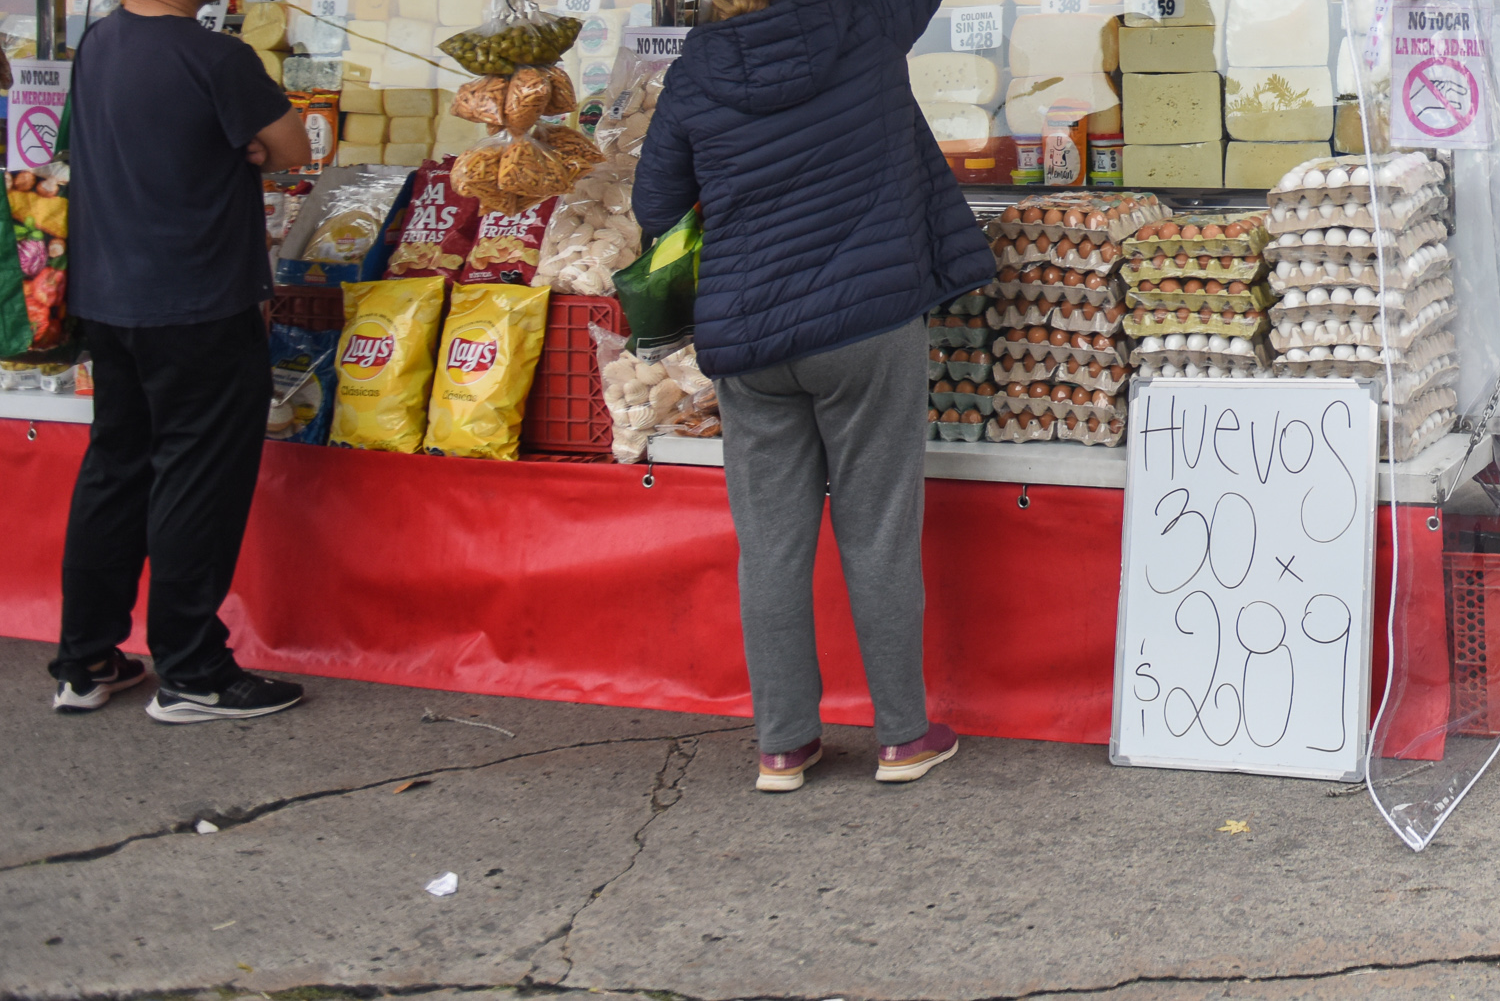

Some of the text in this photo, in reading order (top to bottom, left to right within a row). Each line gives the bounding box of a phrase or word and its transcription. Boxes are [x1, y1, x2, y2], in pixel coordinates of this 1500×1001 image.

[961, 12, 993, 21] COLONIA
[1408, 11, 1470, 31] NO TOCAR
[956, 20, 998, 33] SIN SAL
[637, 38, 650, 54] NO
[960, 32, 993, 49] $428
[1396, 37, 1408, 54] LA
[20, 70, 60, 86] NO TOCAR
[12, 90, 20, 104] LA
[1047, 166, 1073, 180] Alemán
[406, 206, 458, 230] PAS
[401, 230, 446, 243] FRITAS
[481, 226, 528, 238] FRITAS
[344, 334, 393, 367] Lay's
[449, 338, 495, 372] Lay's
[341, 385, 380, 398] Clásicas
[442, 390, 477, 402] Cásicas
[1146, 488, 1257, 594] 30
